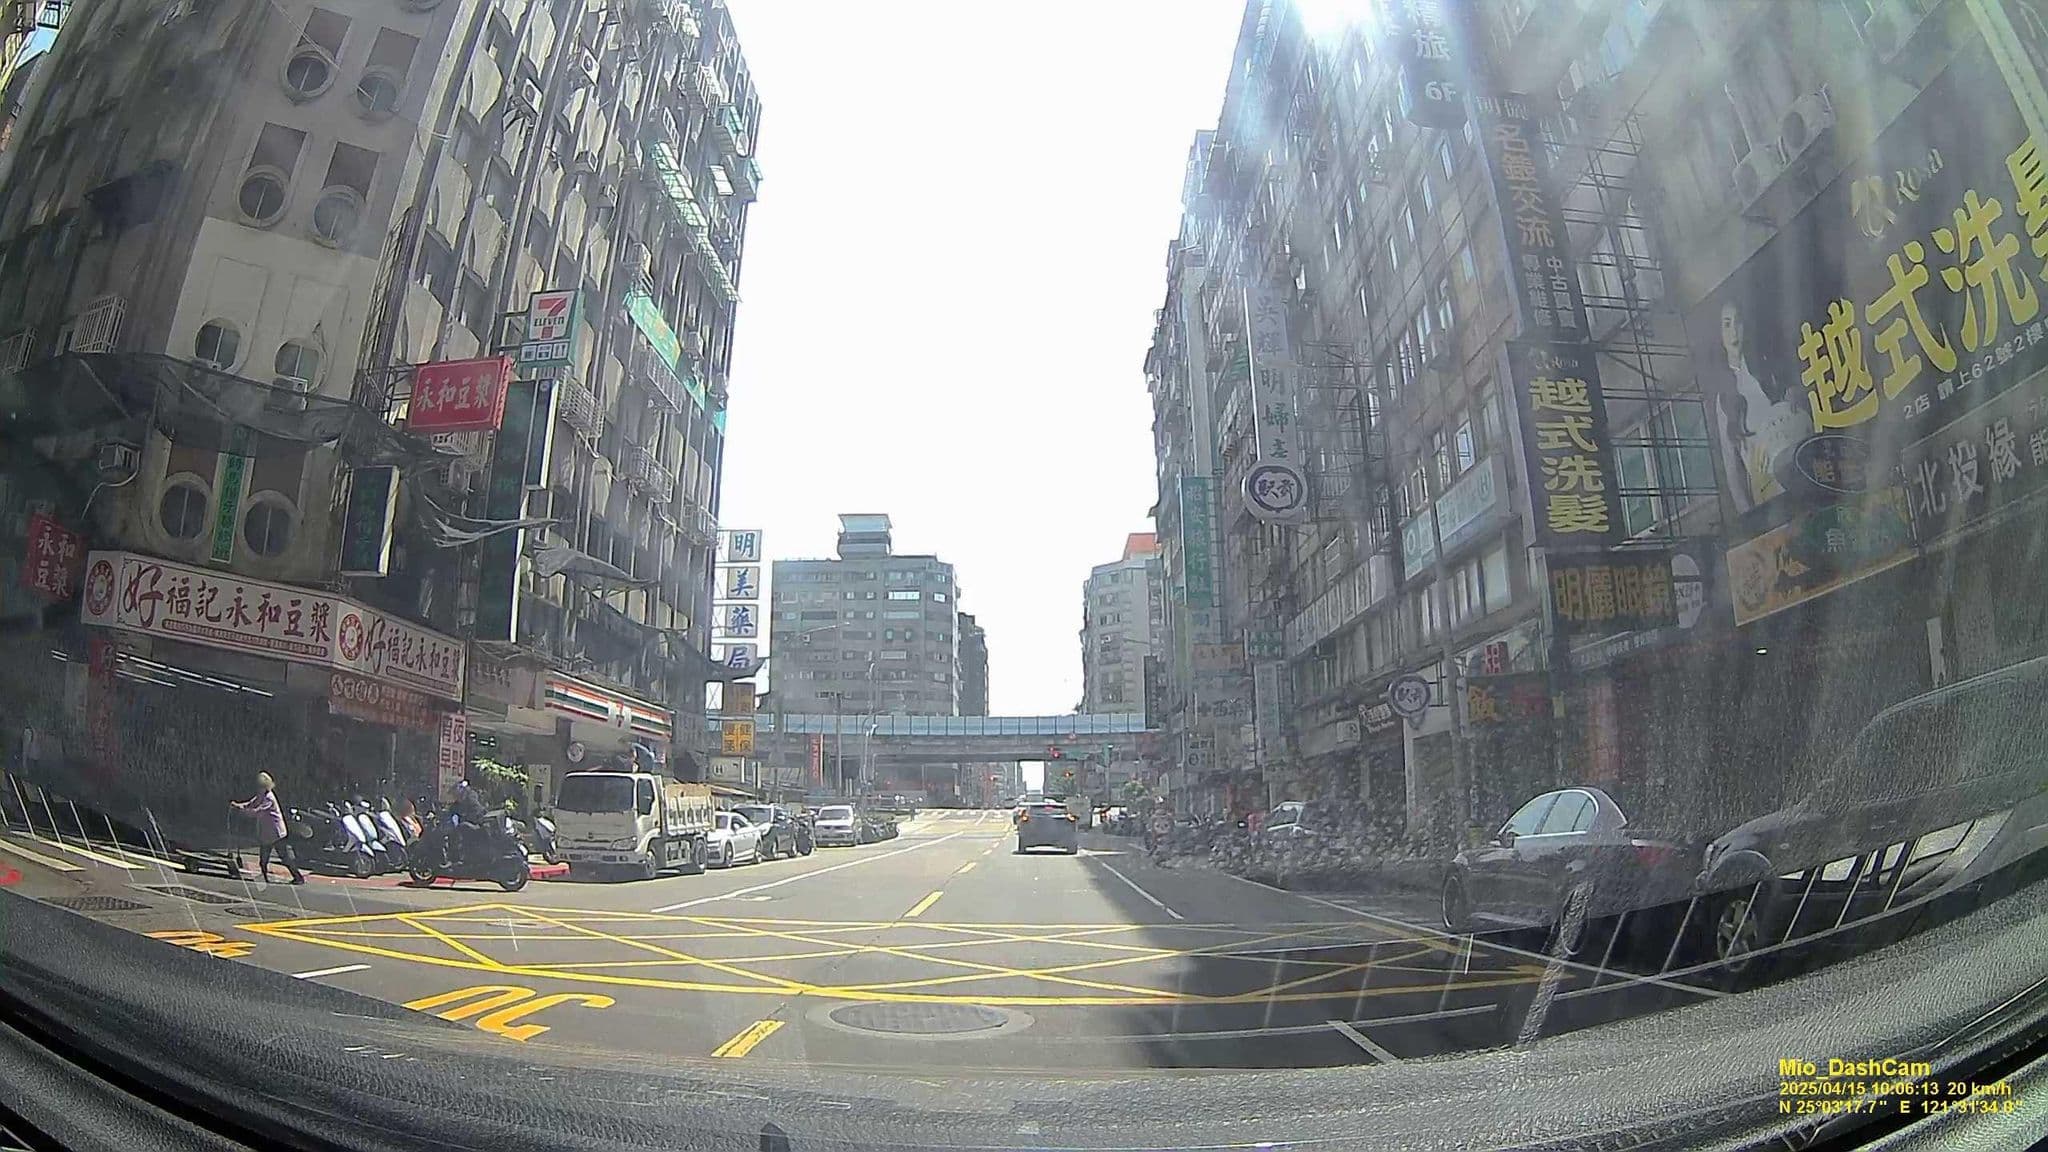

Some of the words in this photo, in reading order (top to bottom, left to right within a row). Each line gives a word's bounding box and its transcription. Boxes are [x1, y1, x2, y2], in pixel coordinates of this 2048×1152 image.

[416, 376, 491, 413] 永和豆漿
[1903, 394, 1931, 420] 2店
[1529, 376, 1611, 535] 越式洗髮
[37, 526, 76, 562] 永和
[35, 560, 73, 600] 豆漿
[123, 564, 332, 644] 好福記永和豆漿
[729, 532, 755, 669] 明美藥局
[364, 614, 463, 686] 好福記永和豆漿
